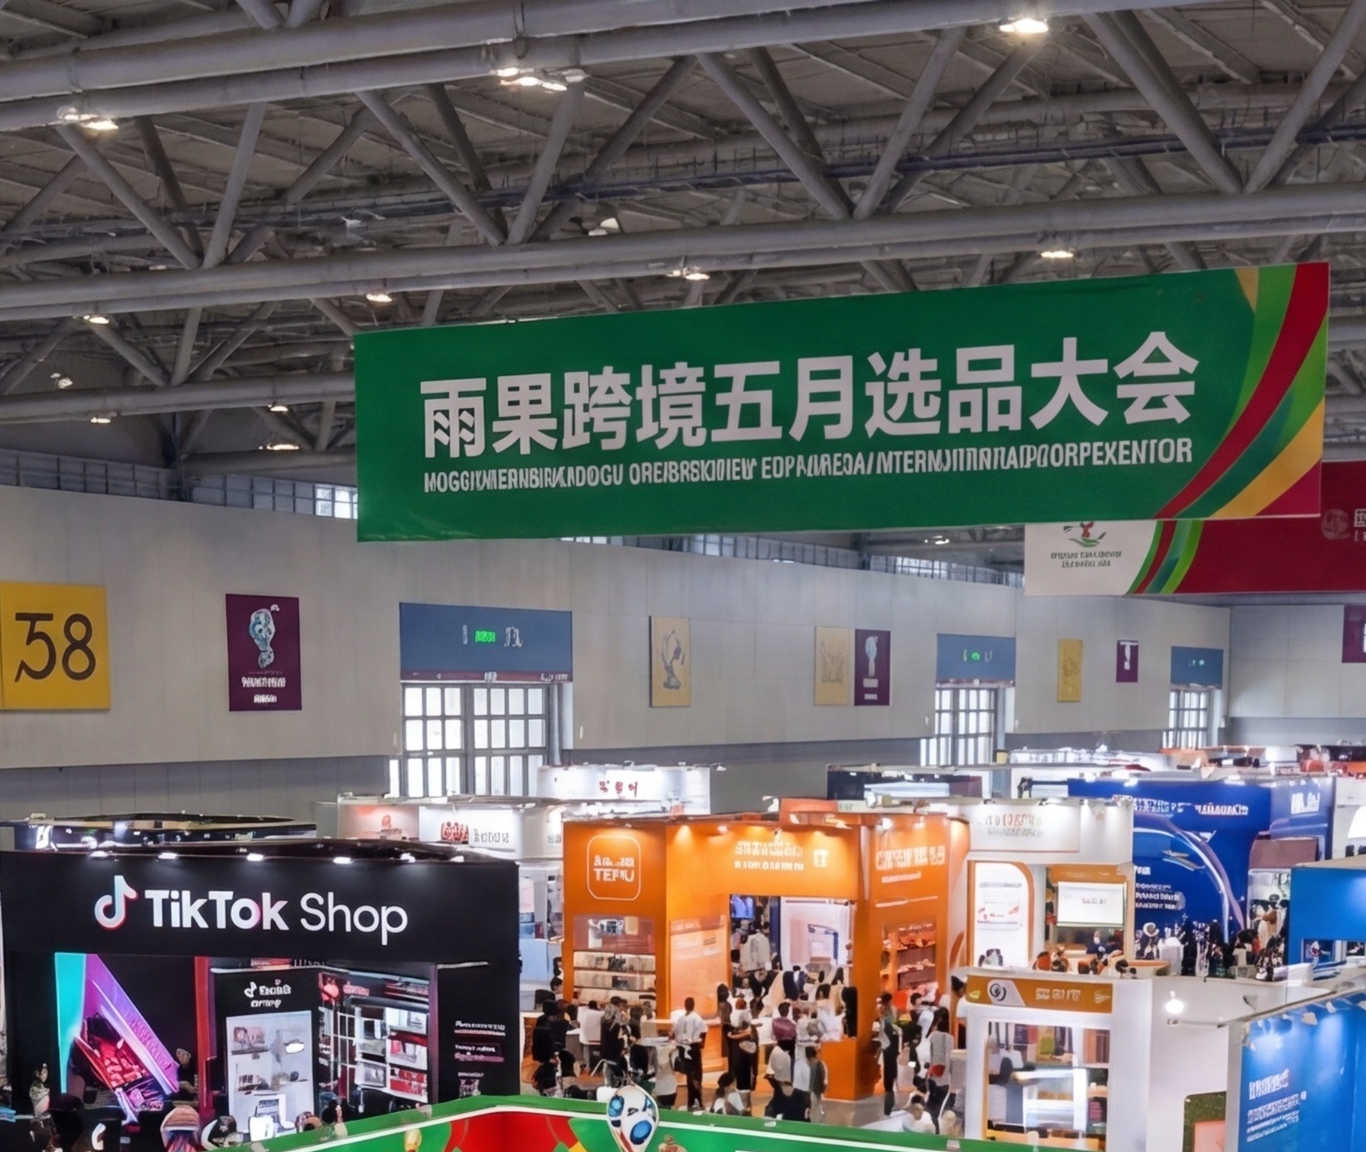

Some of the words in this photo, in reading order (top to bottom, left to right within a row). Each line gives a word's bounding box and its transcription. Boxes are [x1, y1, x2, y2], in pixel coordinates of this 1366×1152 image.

[419, 330, 1199, 460] 雨果跨境五月选品大会
[145, 890, 289, 931] TikTok
[300, 892, 408, 945] Shop
